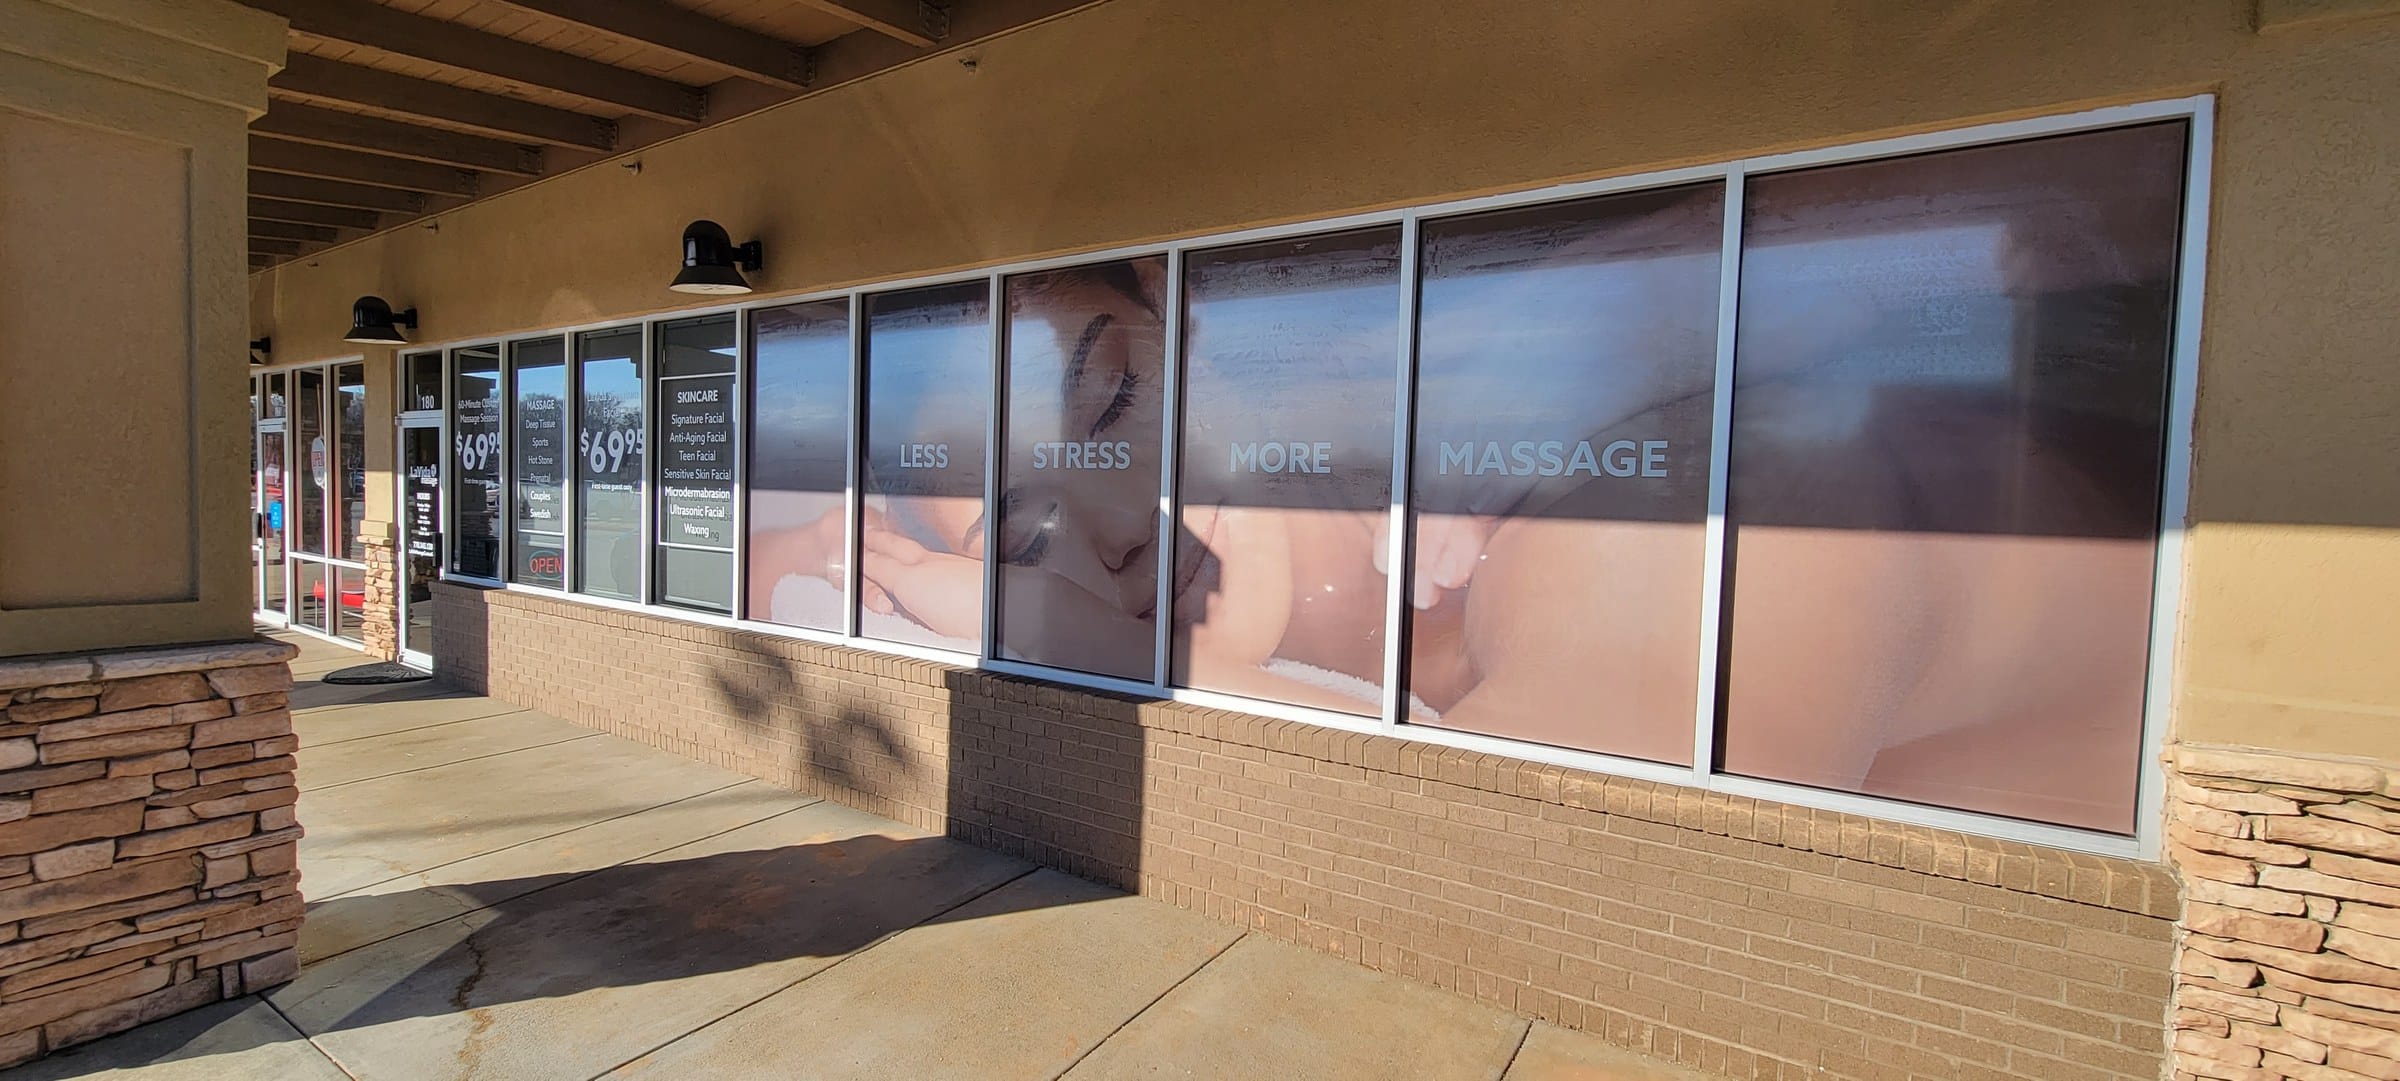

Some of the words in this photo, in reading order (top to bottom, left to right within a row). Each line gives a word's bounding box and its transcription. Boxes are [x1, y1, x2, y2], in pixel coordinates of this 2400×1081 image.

[421, 394, 435, 409] 180
[677, 389, 719, 404] SKINCARE
[526, 400, 555, 411] MASSAGE
[460, 414, 480, 425] Massage
[481, 413, 498, 423] Session
[525, 419, 539, 430] Deep
[539, 418, 555, 429] Tissue
[671, 414, 703, 428] Signature
[705, 412, 724, 424] Facial
[532, 437, 549, 449] Sports
[670, 433, 705, 446] Anti-Aging
[707, 431, 727, 443] Facial
[528, 455, 539, 465] Hot
[539, 455, 553, 466] Stone
[679, 450, 696, 461] Teen
[697, 450, 716, 461] Facial
[900, 443, 948, 469] LESS
[1033, 441, 1131, 470] STRESS
[1230, 441, 1332, 474] MORE
[1439, 440, 1669, 478] MASSAGE
[664, 468, 694, 480] Sensitive
[695, 468, 710, 480] Skin
[711, 468, 731, 481] Facial
[530, 490, 551, 504] Couples
[664, 485, 731, 500] Microdermabrasion
[530, 508, 551, 520] Swedish
[669, 503, 704, 517] Ultrasonic
[704, 505, 725, 518] Facial
[683, 523, 710, 538] Waxing
[529, 558, 562, 574] OPEN
